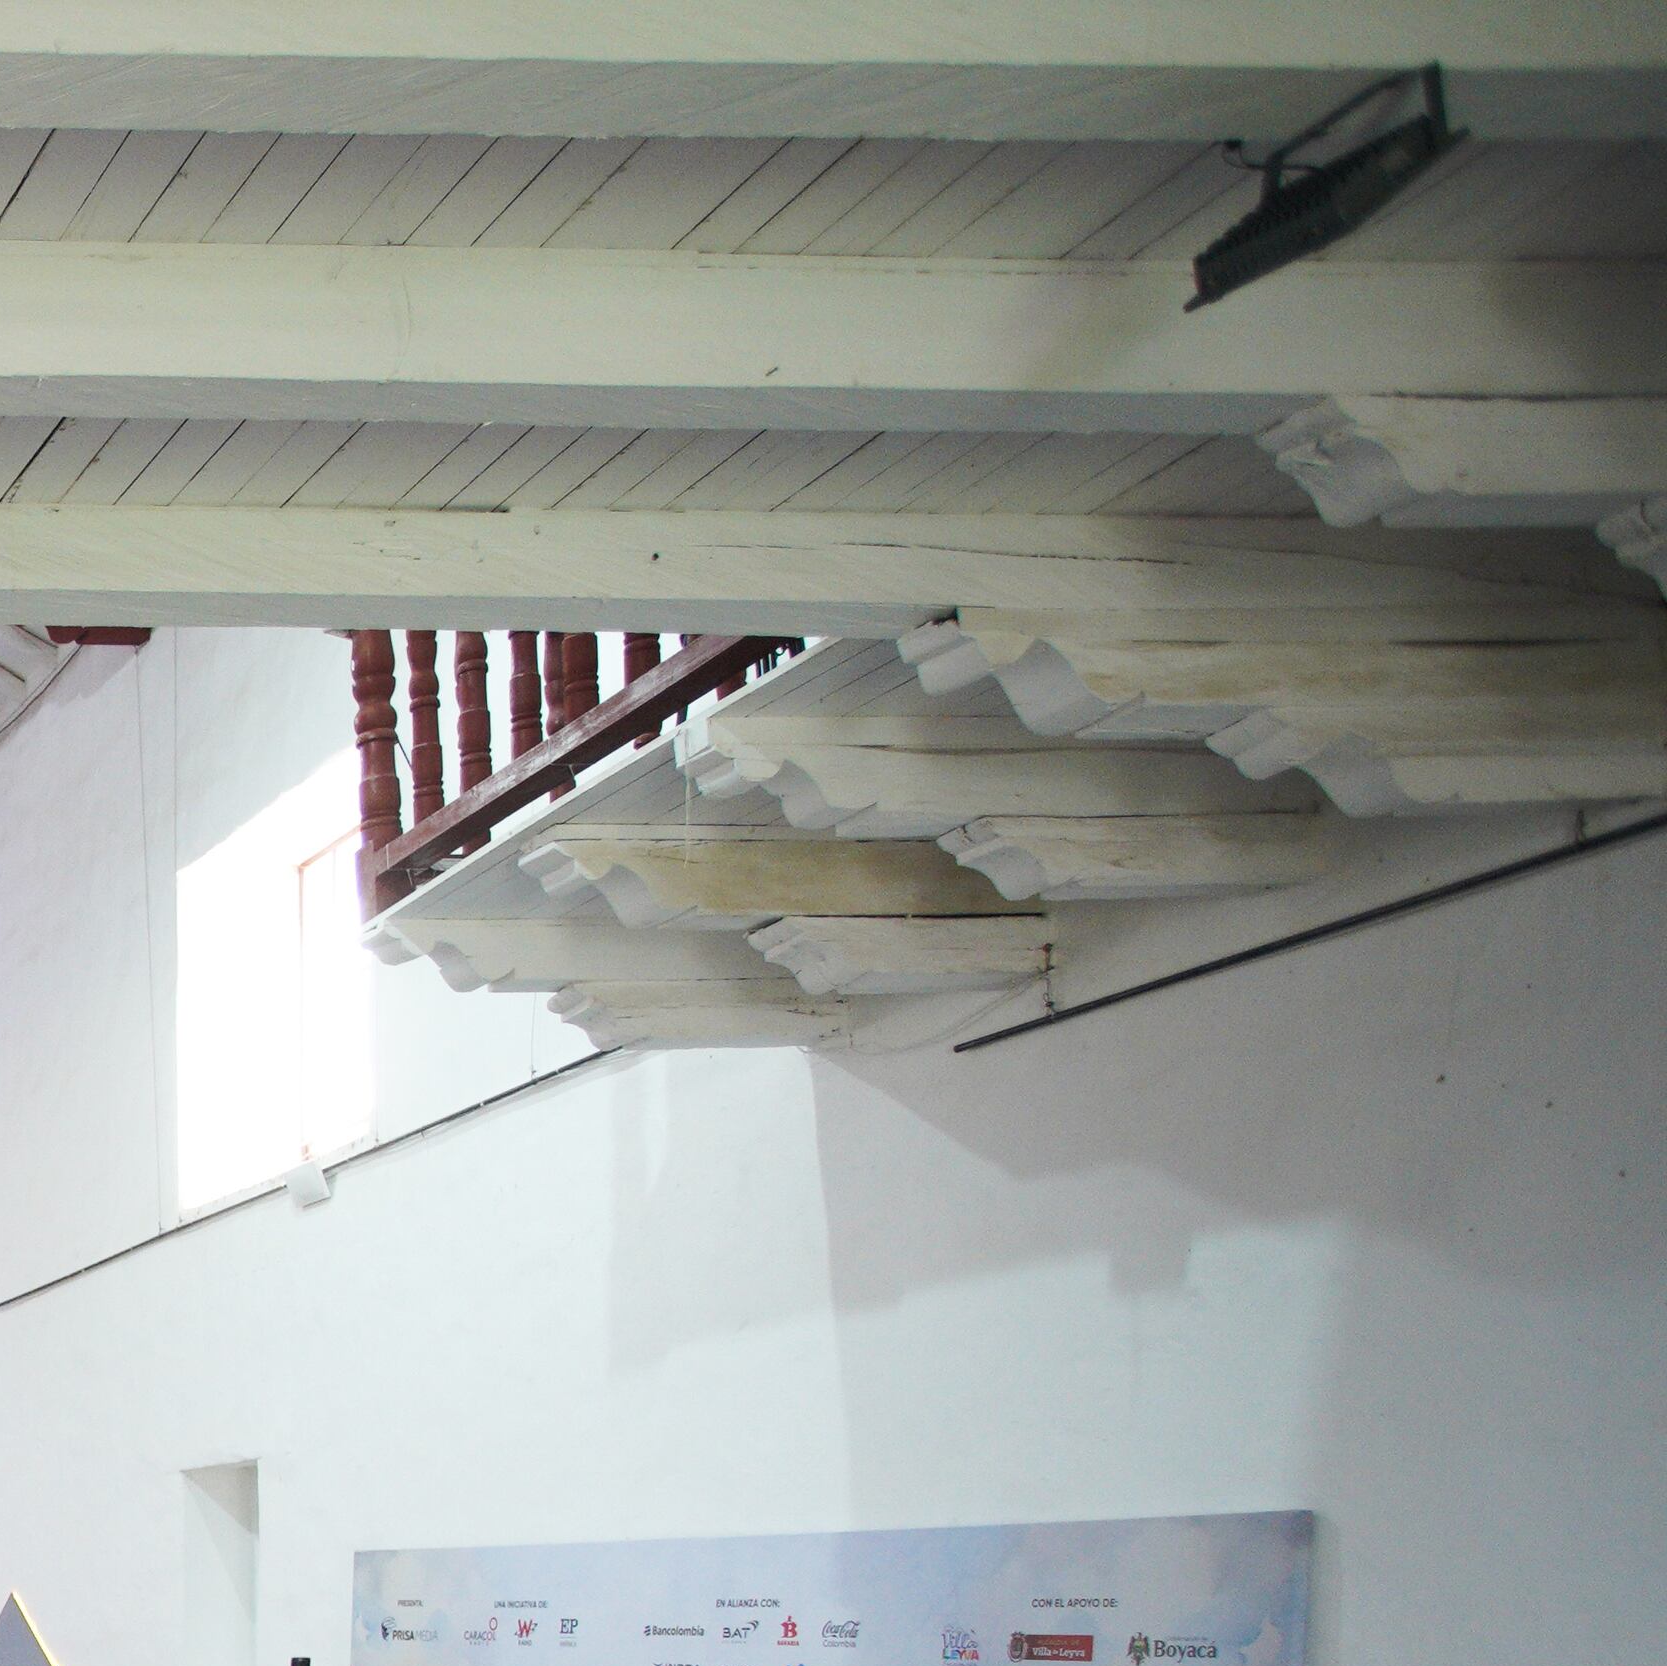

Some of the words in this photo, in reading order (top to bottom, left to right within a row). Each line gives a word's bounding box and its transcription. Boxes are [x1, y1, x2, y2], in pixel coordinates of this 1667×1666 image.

[716, 1599, 727, 1608] EN
[727, 1599, 759, 1608] ALIANZA
[1031, 1598, 1053, 1608] CON
[1054, 1598, 1065, 1608] EL
[1067, 1598, 1100, 1608] APOYO
[1102, 1598, 1118, 1608] DE:
[560, 1618, 578, 1635] EP
[652, 1625, 705, 1637] Bancolombia
[392, 1630, 414, 1641] PRISA
[463, 1630, 496, 1641] CARACOL
[722, 1627, 750, 1639] BAT
[823, 1639, 856, 1648] Colombia
[1032, 1647, 1052, 1657] Villa
[1059, 1648, 1085, 1659] Leyva
[1154, 1640, 1217, 1663] Boyacá
